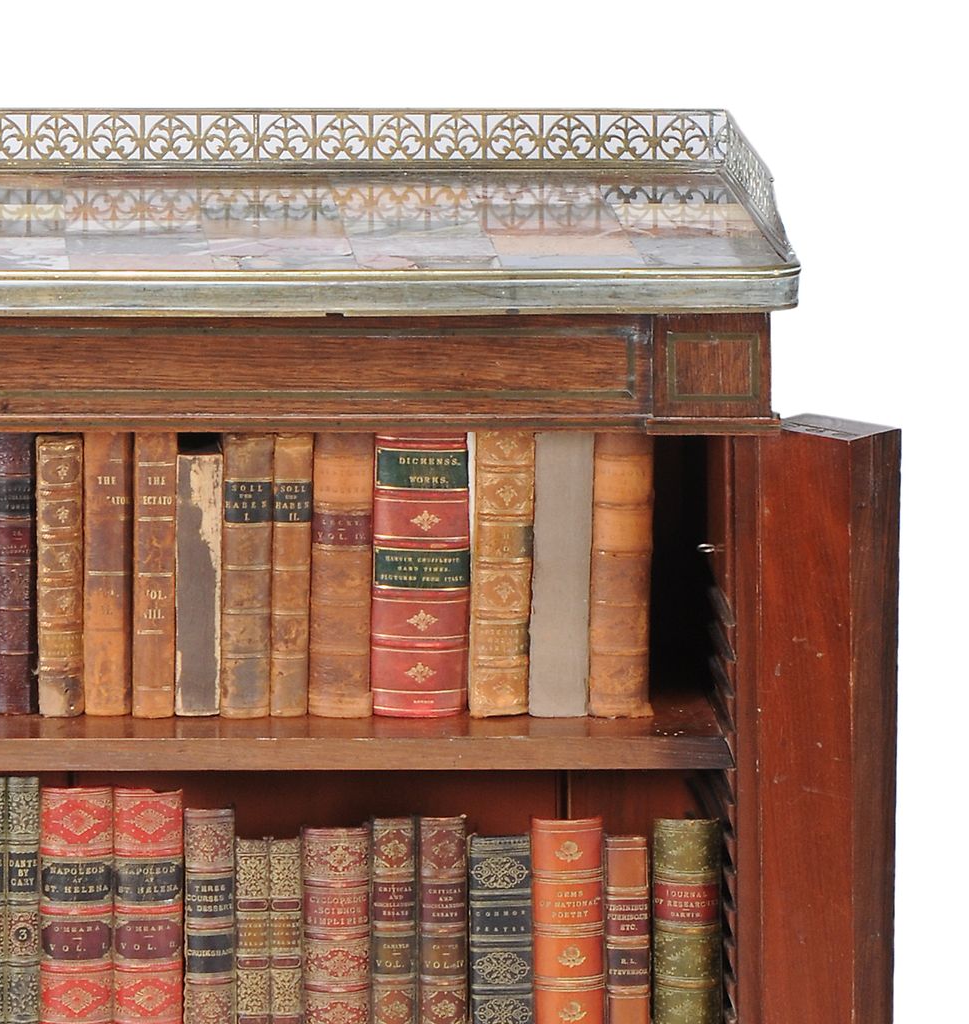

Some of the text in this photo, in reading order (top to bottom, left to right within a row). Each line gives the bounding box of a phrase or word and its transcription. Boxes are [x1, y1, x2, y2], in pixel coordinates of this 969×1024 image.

[98, 477, 116, 485] THE
[148, 477, 166, 485] THE
[409, 476, 449, 484] WORKS.
[50, 866, 104, 875] NAPOLEON
[11, 878, 34, 886] CARY
[45, 885, 108, 893] ST. HELENA
[118, 885, 178, 894] ST. HELENA
[186, 894, 224, 902] COURSES
[666, 890, 708, 898] JOURNAL
[19, 930, 27, 940] 3
[50, 943, 86, 952] VOL.
